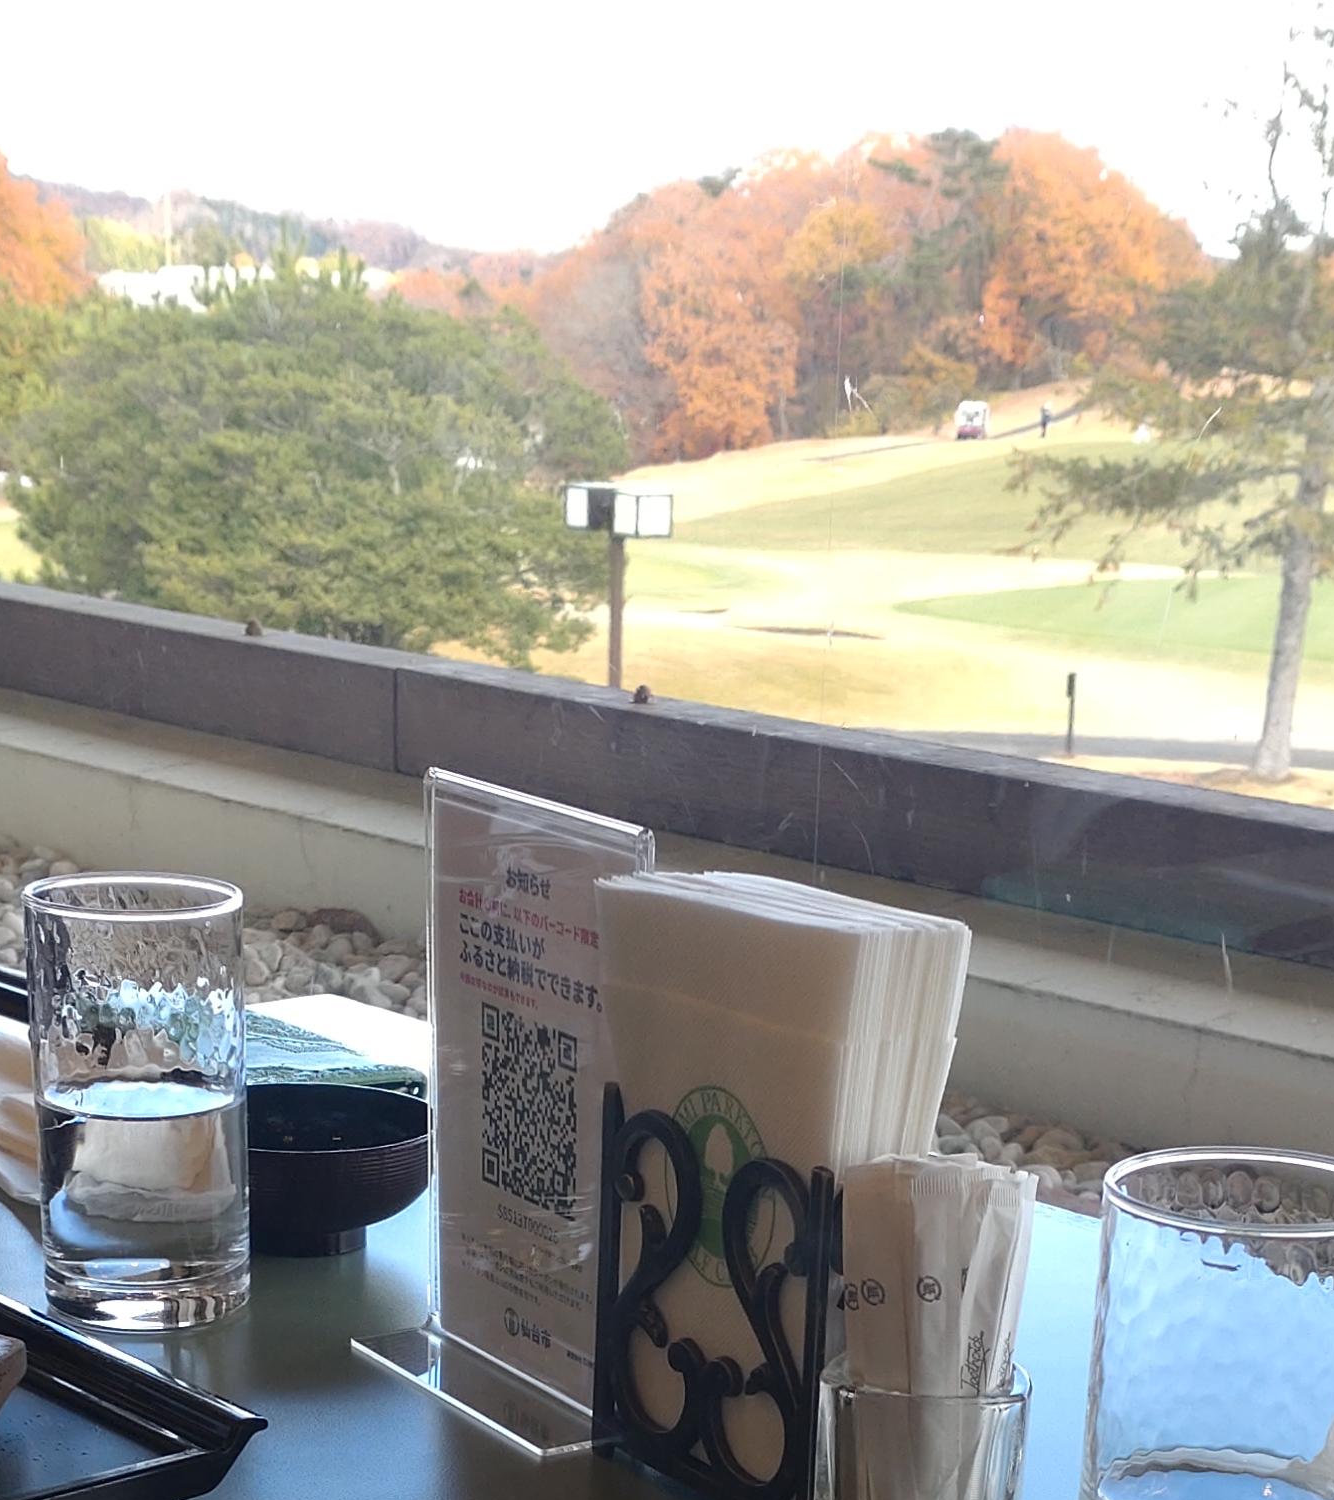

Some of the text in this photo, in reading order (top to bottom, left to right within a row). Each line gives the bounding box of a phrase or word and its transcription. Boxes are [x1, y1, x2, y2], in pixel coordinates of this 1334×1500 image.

[506, 867, 551, 899] お知らせ
[459, 913, 545, 960] ここの支払いが
[460, 941, 602, 1013] ふるさと納税でできます。
[521, 1318, 551, 1348] 仙台市
